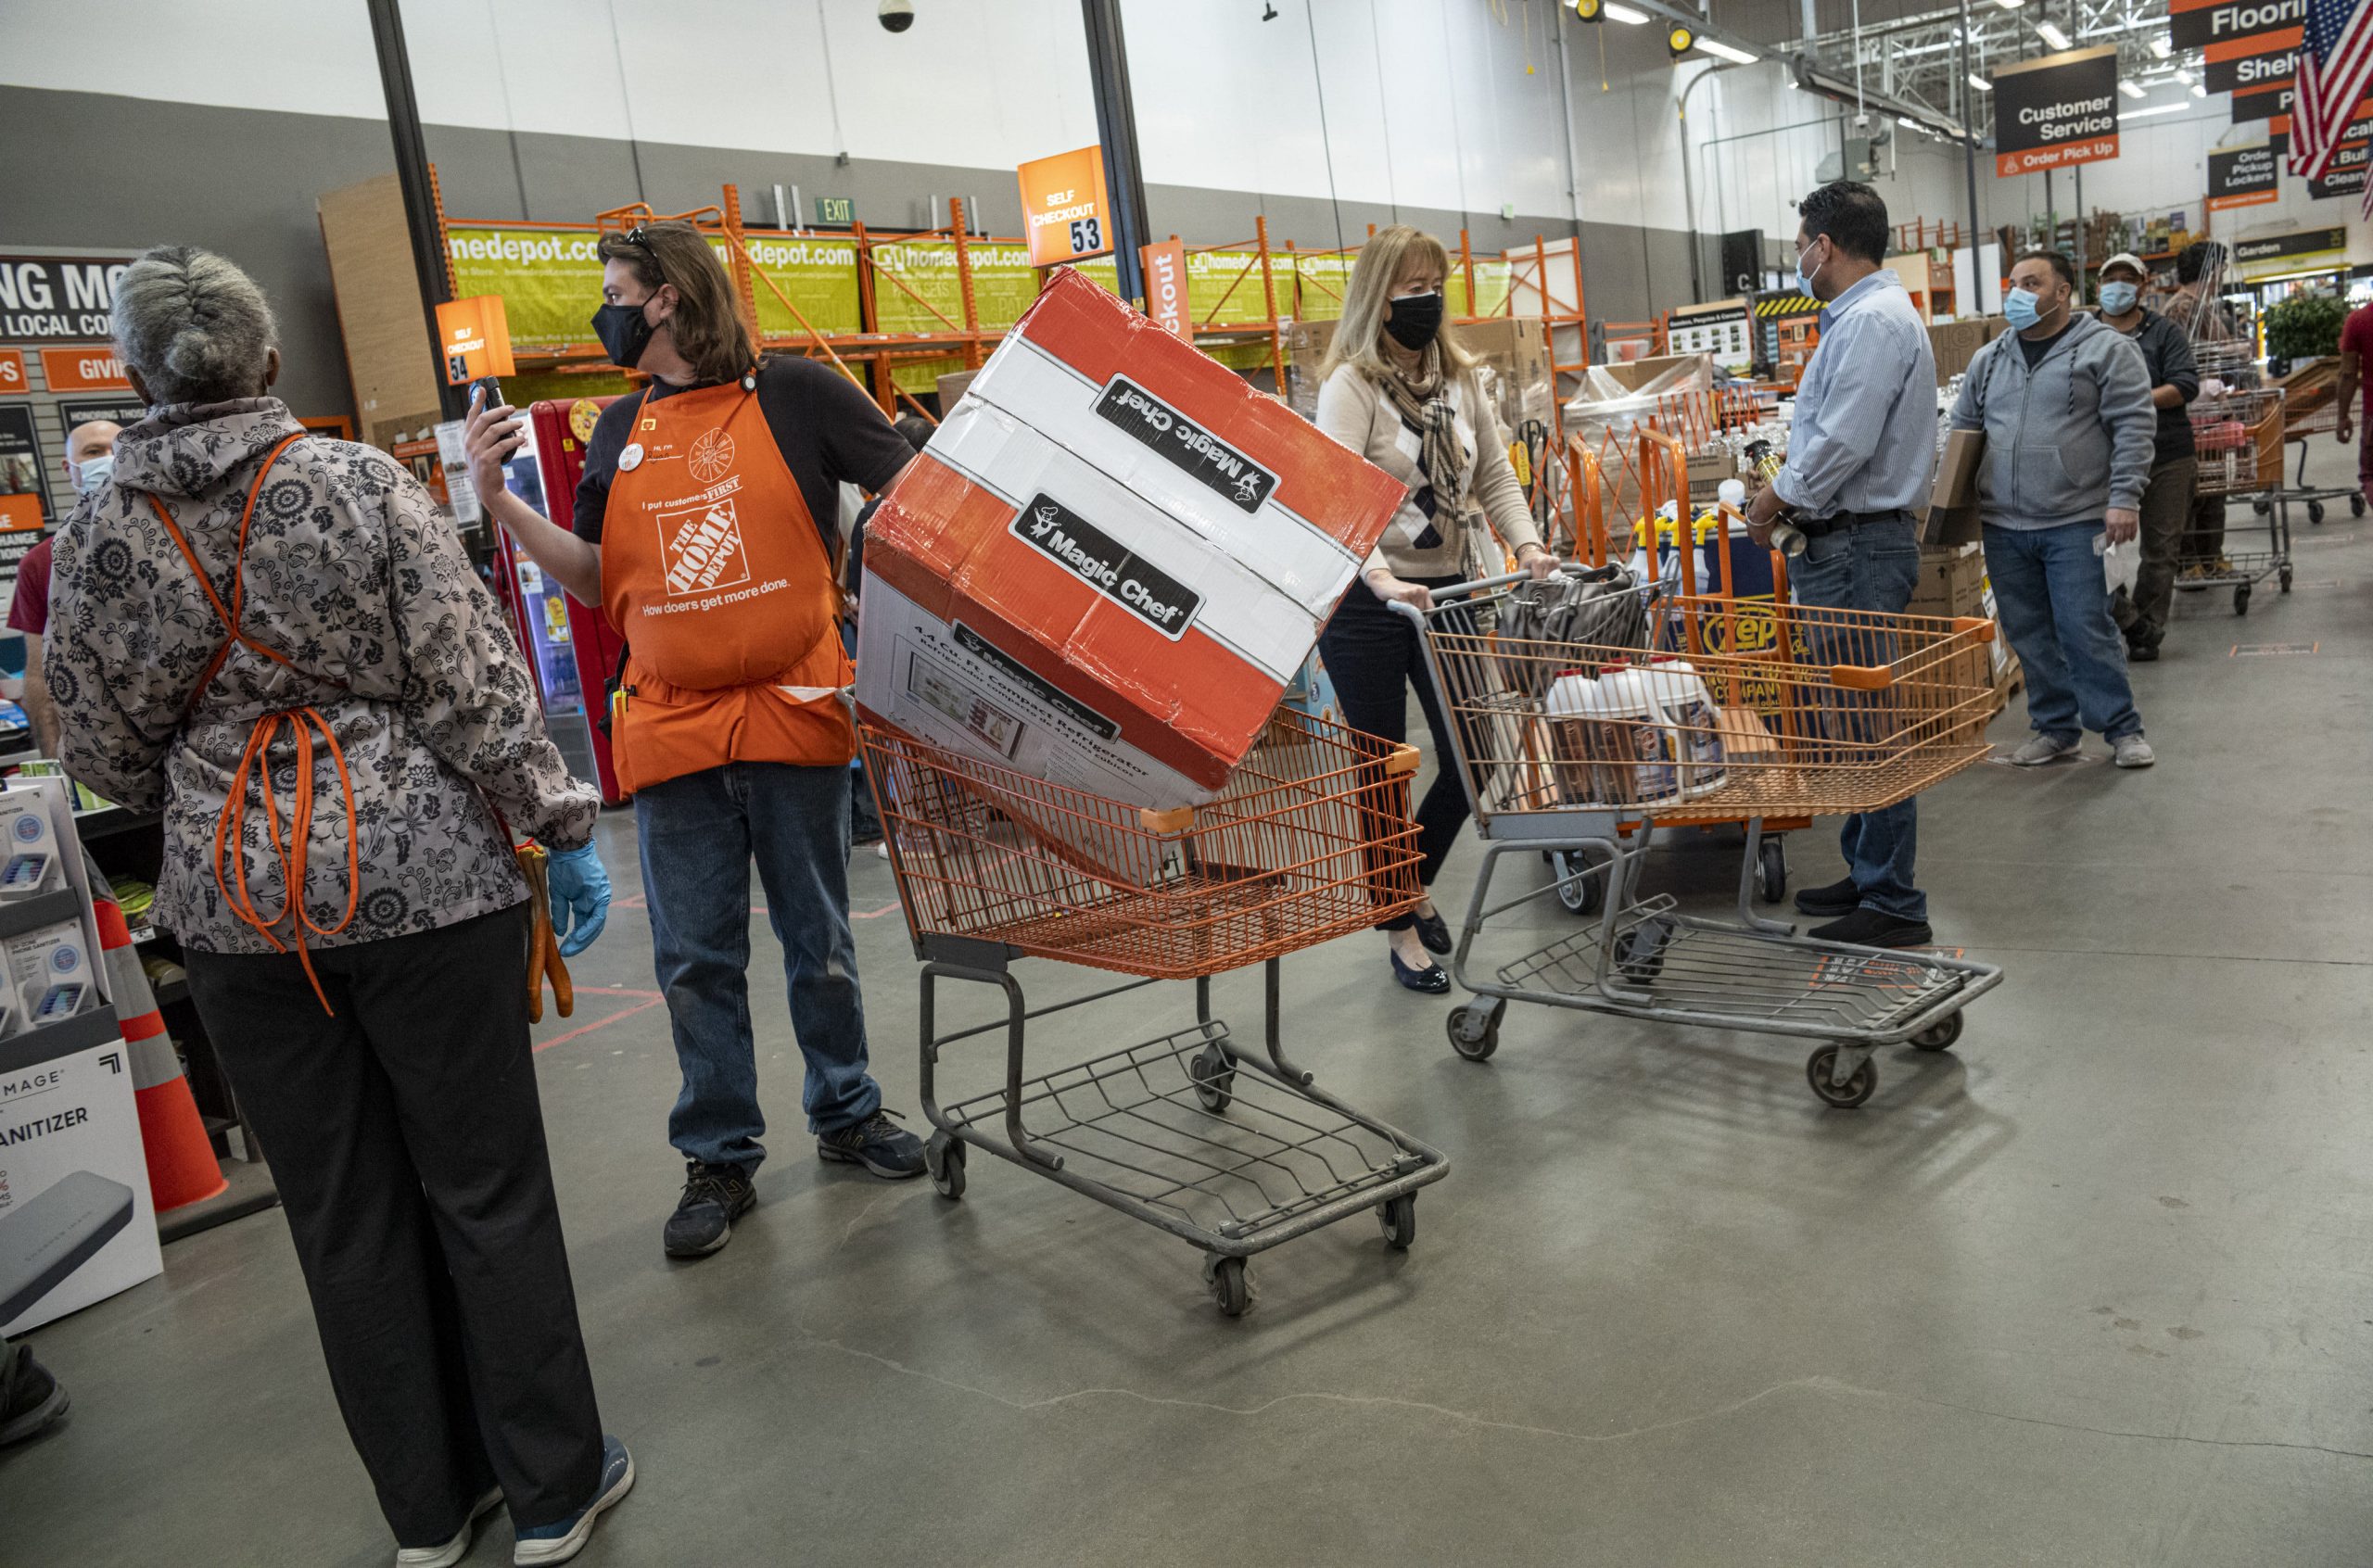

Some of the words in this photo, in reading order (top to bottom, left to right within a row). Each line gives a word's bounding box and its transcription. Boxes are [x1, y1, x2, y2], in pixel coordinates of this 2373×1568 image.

[2019, 95, 2113, 124] Customer
[2040, 116, 2113, 140] Service
[2023, 152, 2061, 167] Order
[2063, 145, 2091, 160] Pick
[2094, 142, 2113, 156] Up
[2232, 161, 2274, 175] Pickup
[2226, 172, 2274, 188] Lockers
[824, 198, 850, 222] EXIT
[1046, 189, 1075, 208] SELF
[1031, 202, 1096, 228] CHECKOUT
[1070, 218, 1101, 253] 53
[2238, 243, 2280, 258] Garden
[5, 315, 77, 336] LOCAL
[80, 315, 115, 335] CO
[454, 327, 472, 340] SELF
[447, 338, 485, 356] CHECKOUT
[450, 355, 468, 382] 54
[1116, 388, 1174, 432] Chef
[1174, 424, 1244, 479] Magic
[641, 501, 646, 510] I
[648, 500, 663, 512] put
[665, 493, 707, 508] customers
[706, 477, 740, 500] FIRST
[667, 503, 736, 593] HOME
[669, 519, 699, 554] THE
[698, 530, 741, 588] DEPOT
[1047, 529, 1118, 587] Magic
[1120, 578, 1179, 625] Chef
[641, 605, 664, 618] How
[664, 599, 700, 614] doers
[700, 595, 723, 612] get
[724, 587, 759, 604] more
[759, 577, 792, 594] done.
[914, 626, 936, 642] 4.4
[988, 674, 1055, 721] Compact
[1058, 718, 1149, 778] Refrigerator
[983, 651, 1047, 700] Magic
[1050, 698, 1104, 734] Chef
